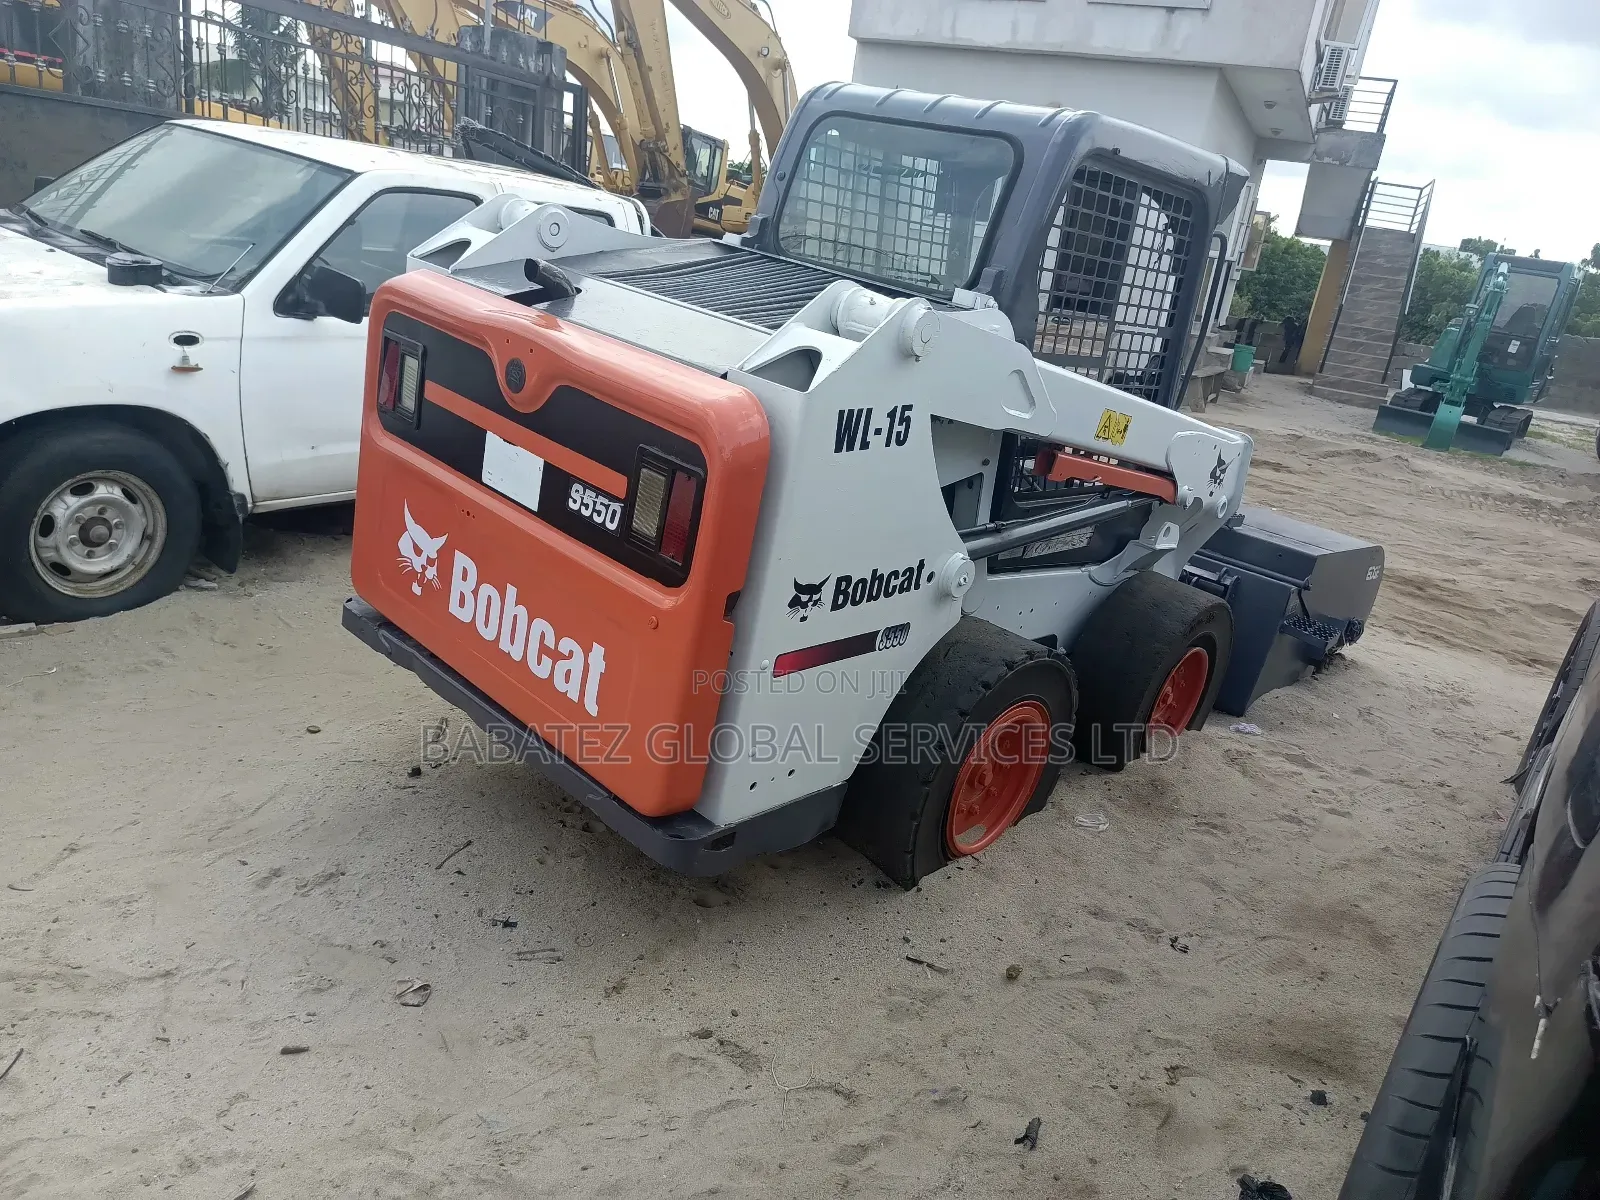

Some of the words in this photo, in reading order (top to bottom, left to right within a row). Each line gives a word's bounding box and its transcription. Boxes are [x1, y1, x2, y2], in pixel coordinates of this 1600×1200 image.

[708, 206, 720, 221] CAT
[833, 404, 914, 453] WL-15
[568, 482, 622, 531] S550
[829, 558, 926, 612] Bobcat
[448, 548, 606, 717] Bobcat
[877, 621, 911, 652] S550
